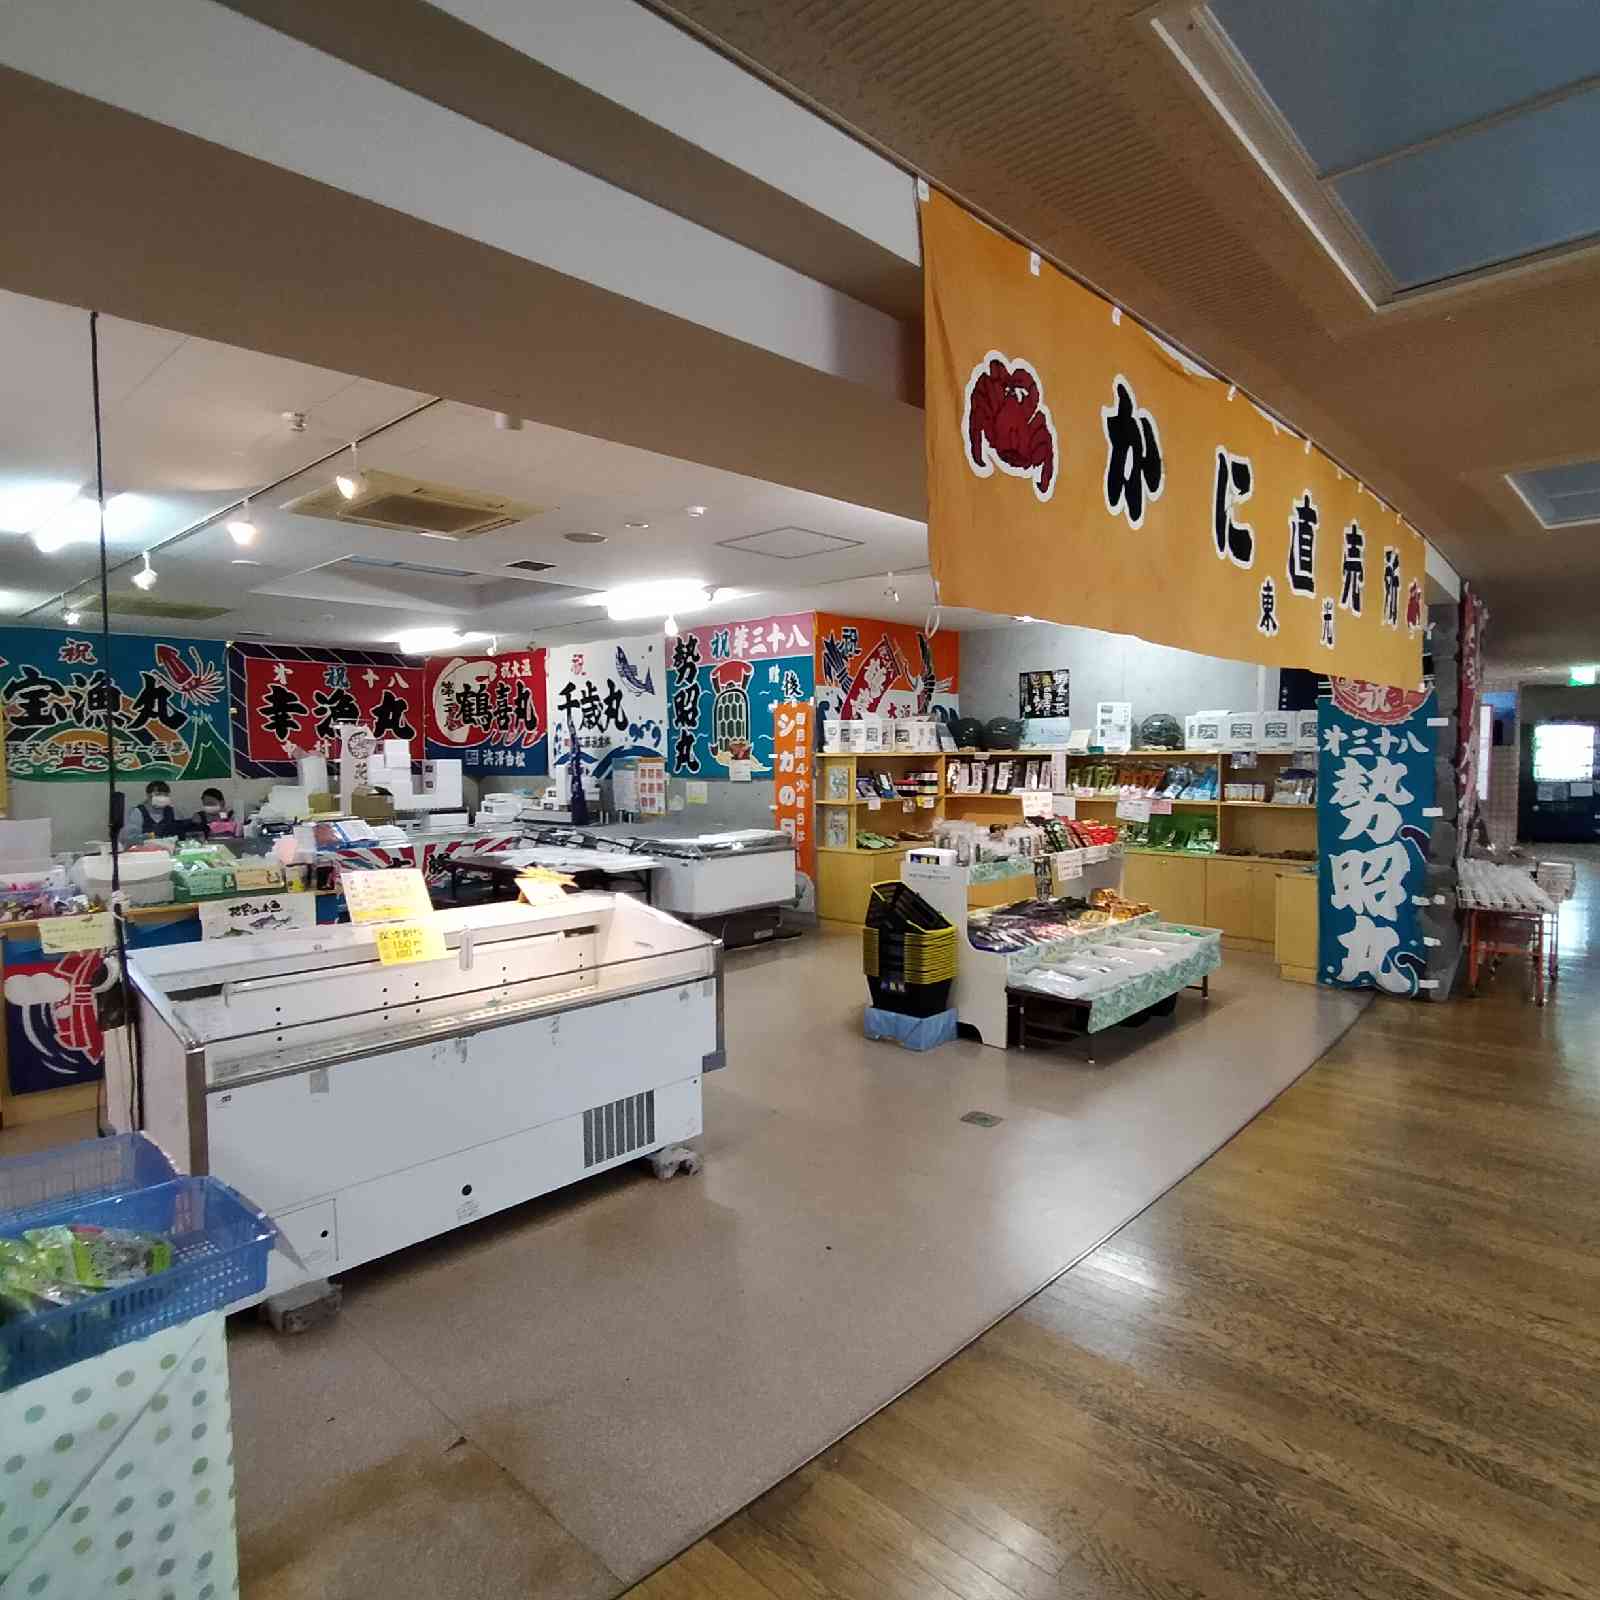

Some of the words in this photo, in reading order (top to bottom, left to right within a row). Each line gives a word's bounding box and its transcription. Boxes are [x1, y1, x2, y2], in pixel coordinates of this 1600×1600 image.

[58, 637, 97, 665] 祝
[710, 630, 730, 659] 祝
[558, 678, 629, 733] 千歳丸
